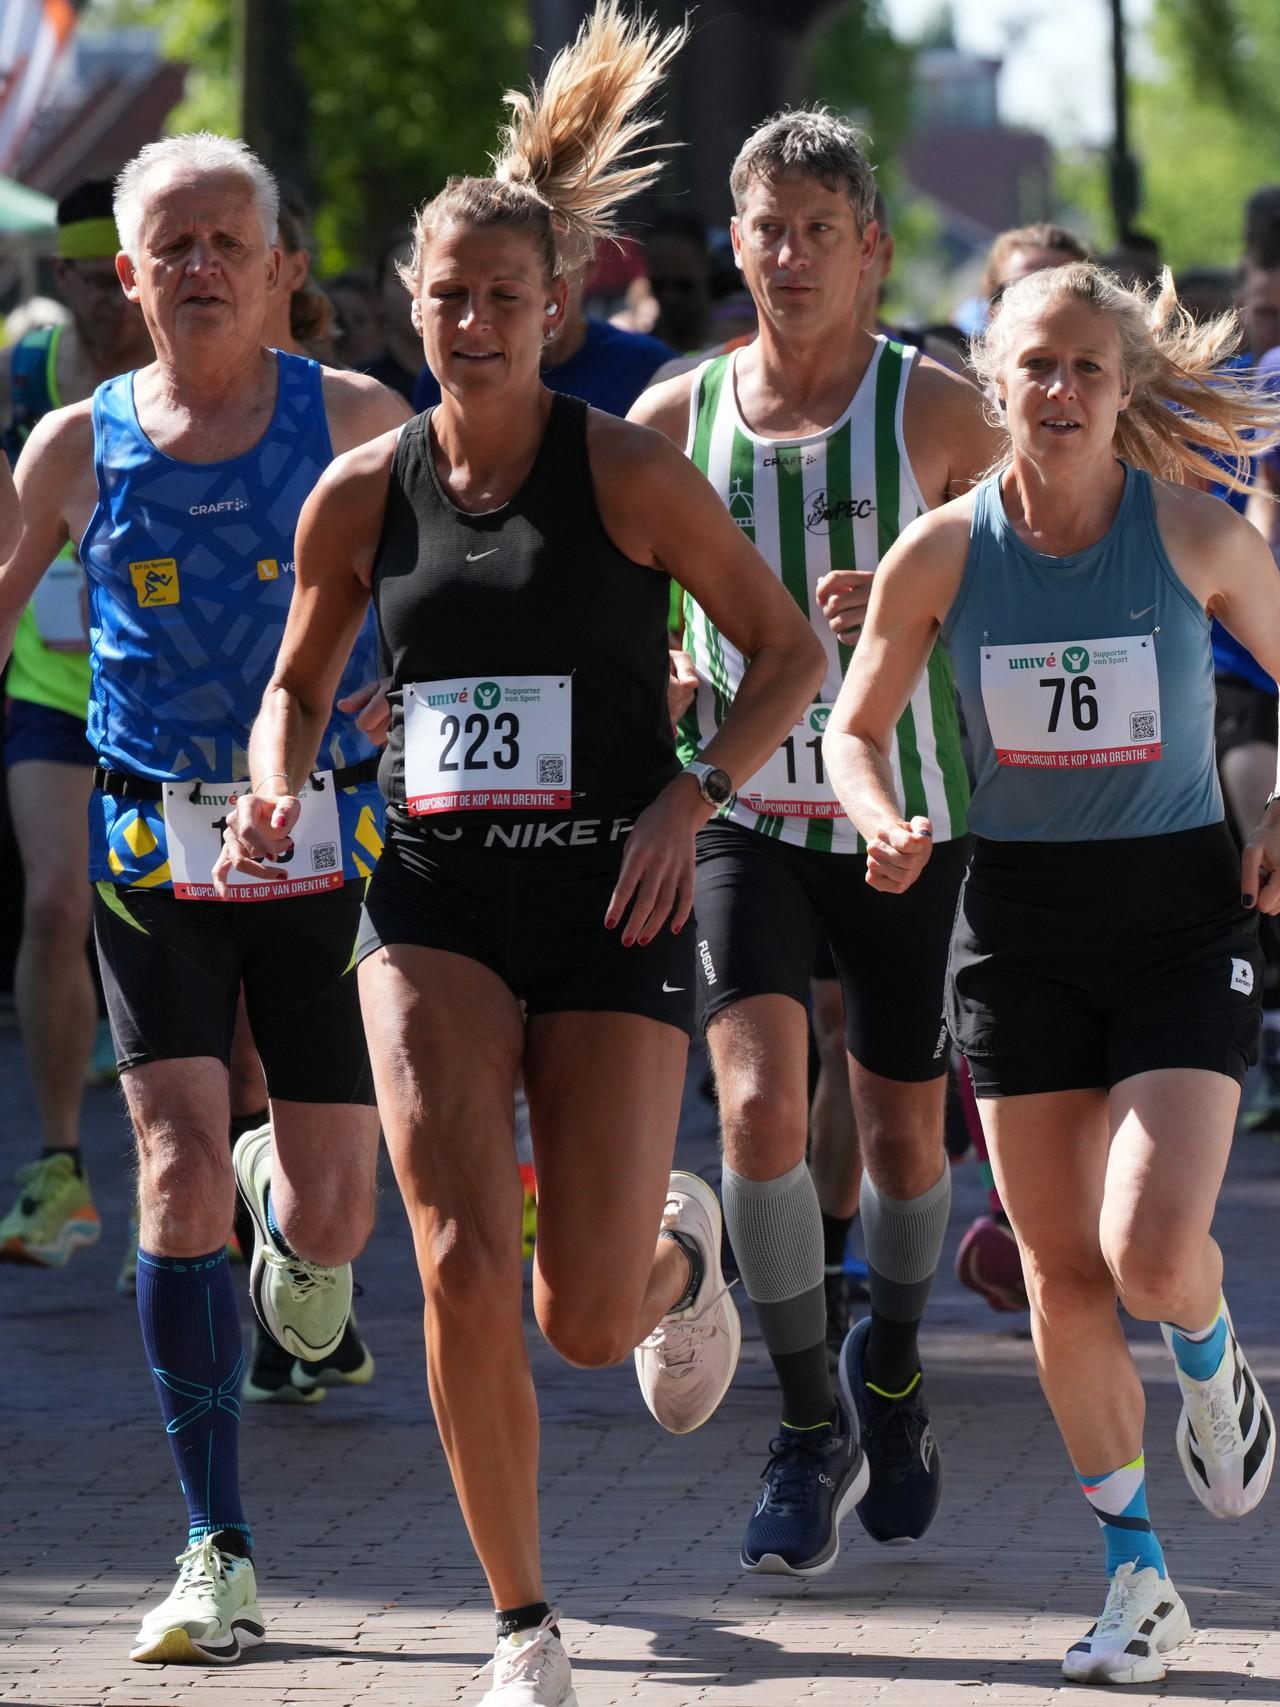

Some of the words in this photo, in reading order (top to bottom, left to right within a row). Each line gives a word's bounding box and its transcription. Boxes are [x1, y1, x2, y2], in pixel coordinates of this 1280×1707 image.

[763, 456, 804, 467] CRAFT
[189, 501, 234, 516] CRAFT
[281, 560, 295, 573] ve
[1008, 652, 1057, 669] univé
[1093, 649, 1128, 659] Supporter
[1108, 656, 1128, 665] Sport
[427, 687, 468, 706] univé
[504, 687, 541, 696] Supporter
[520, 695, 540, 703] Sport
[1039, 675, 1099, 733] 76
[439, 712, 519, 772] 223
[780, 736, 824, 784] 11
[1008, 752, 1057, 766] LOOPCIRCUIT
[1059, 755, 1069, 766] DE
[1071, 753, 1088, 766] KOP
[1089, 752, 1107, 764] VAN
[1109, 749, 1148, 763] DRENTHE
[415, 795, 458, 811] LOOPCIRCUIT
[459, 795, 471, 806] DE
[473, 794, 490, 805] KOP
[491, 794, 510, 805] VAN
[512, 794, 555, 805] DRENTHE
[751, 802, 801, 814] LOOPCIRCUIT
[803, 804, 813, 814] DE
[815, 805, 831, 815] KOP
[833, 804, 847, 814] VA
[484, 820, 601, 848] NIKE
[186, 885, 238, 897] LOOPCIUIT
[240, 888, 251, 898] DE
[253, 886, 270, 897] KOP
[272, 884, 290, 895] VAN
[291, 877, 330, 893] DRENTHE
[698, 940, 717, 985] FUSION
